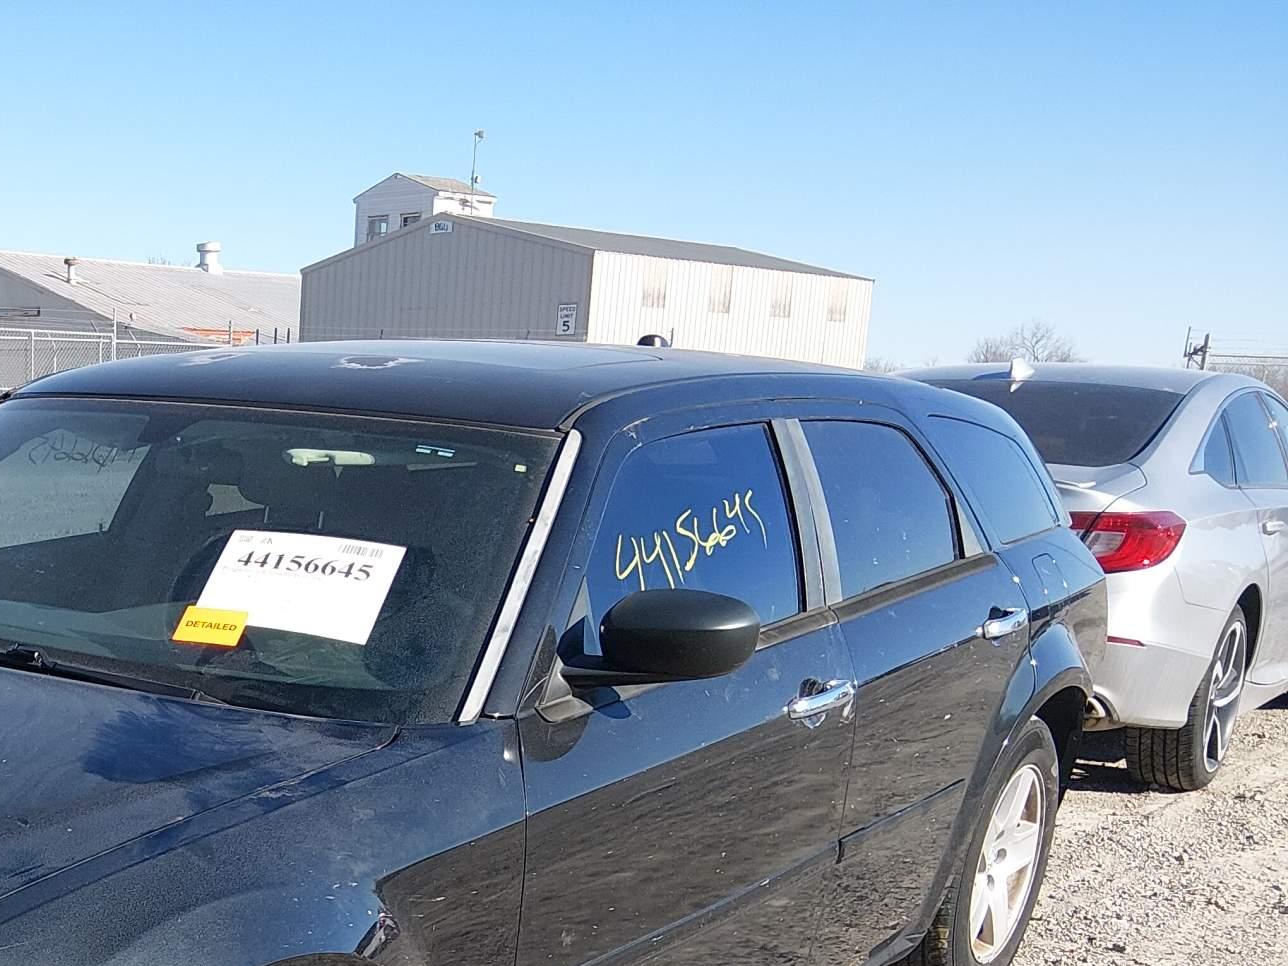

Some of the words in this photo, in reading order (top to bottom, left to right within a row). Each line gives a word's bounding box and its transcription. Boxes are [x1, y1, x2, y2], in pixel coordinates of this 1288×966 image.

[562, 320, 570, 332] 5
[237, 550, 374, 582] 44156645
[184, 620, 238, 633] DETAILED
